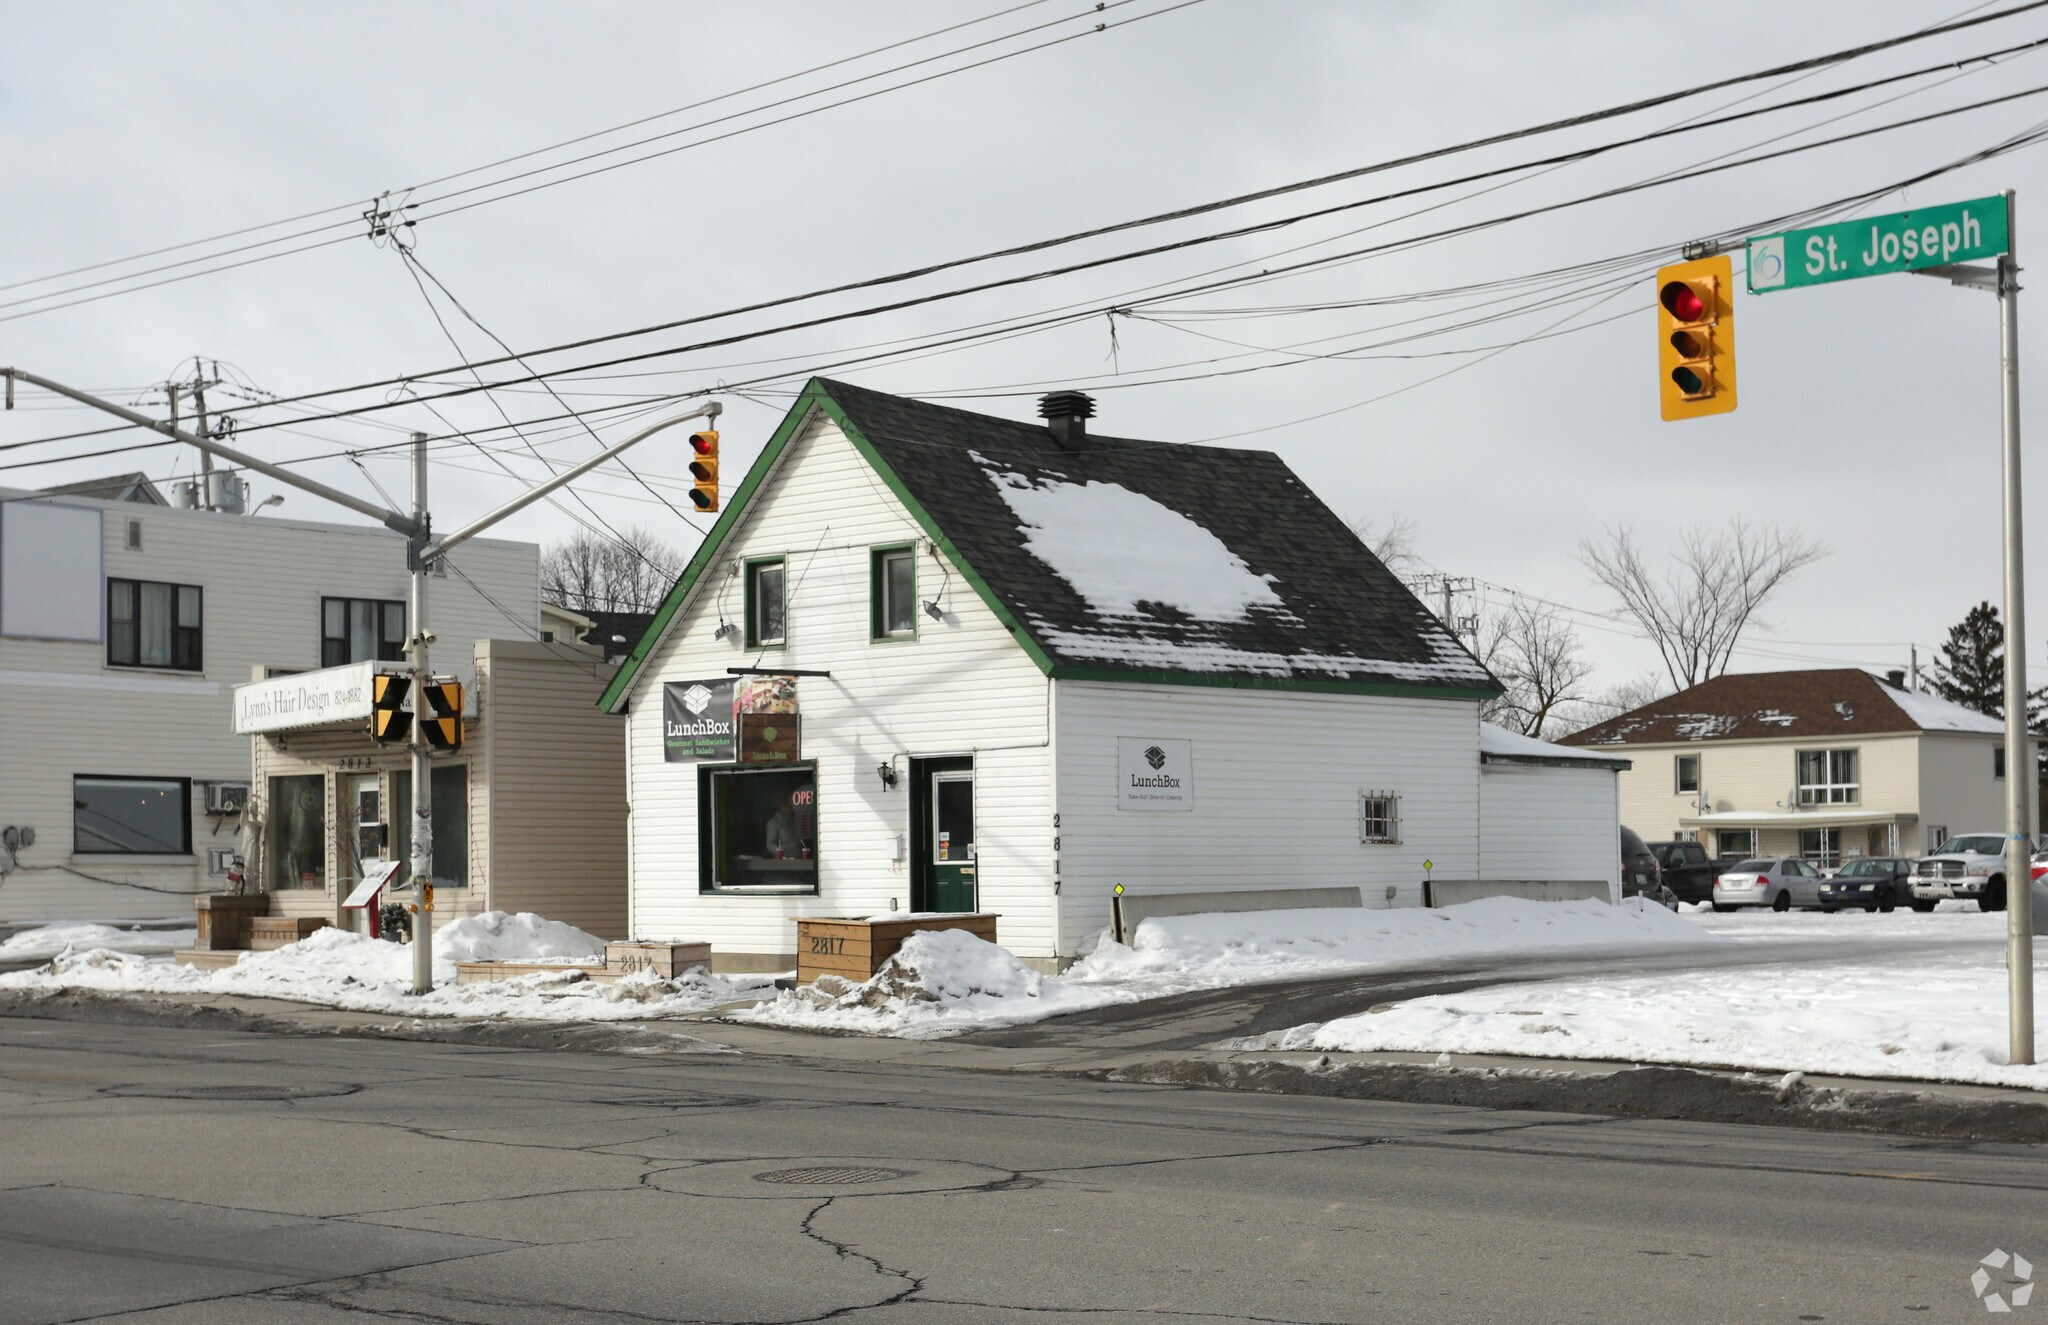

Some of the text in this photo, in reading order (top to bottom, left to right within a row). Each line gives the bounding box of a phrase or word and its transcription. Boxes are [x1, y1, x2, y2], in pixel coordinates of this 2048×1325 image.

[1805, 210, 1981, 276] St. Joseph
[241, 692, 271, 727] Lynn's
[273, 690, 296, 714] Hair
[298, 686, 330, 717] Design
[667, 718, 730, 737] LunchBox
[667, 737, 731, 747] Gourmet Sandwiches
[695, 747, 715, 755] Salads
[752, 751, 787, 760] LunchBox
[339, 757, 372, 769] 2813
[1131, 774, 1180, 788] LunchBox
[811, 936, 845, 955] 2817
